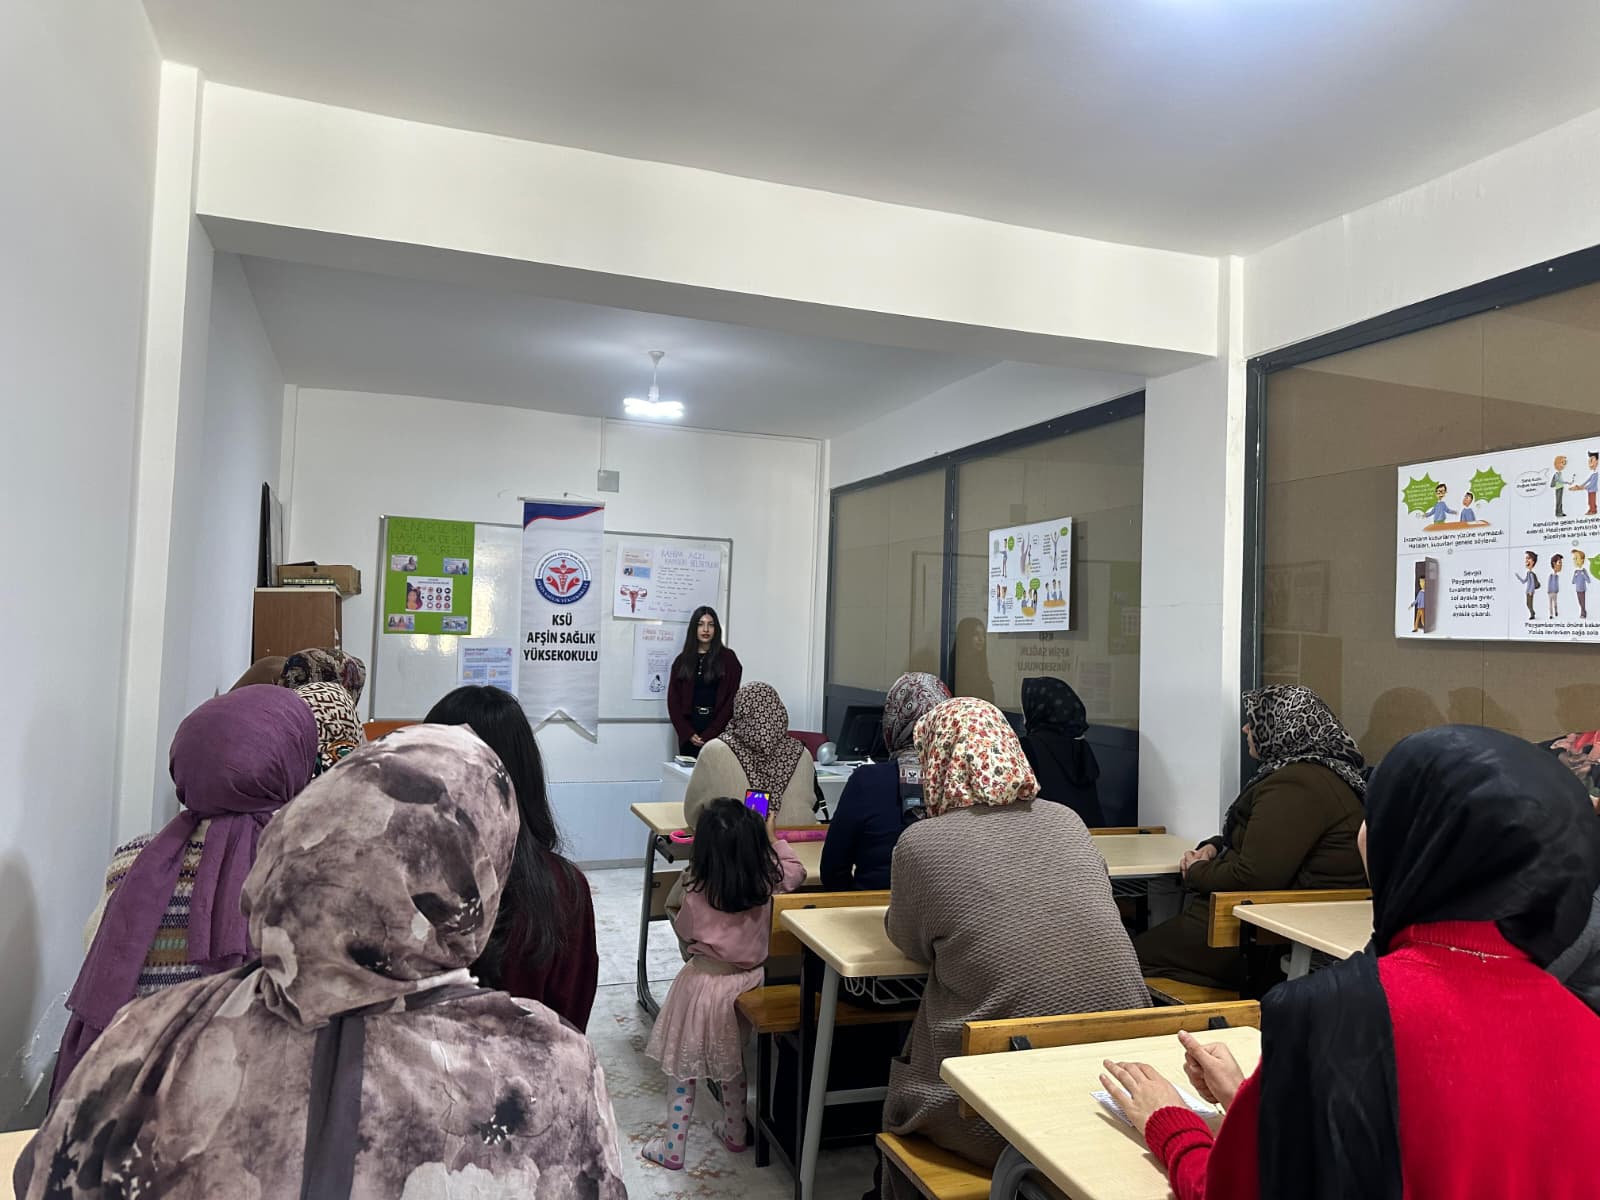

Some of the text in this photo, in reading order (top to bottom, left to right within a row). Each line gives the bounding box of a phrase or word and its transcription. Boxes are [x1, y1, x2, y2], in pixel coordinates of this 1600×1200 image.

[552, 612, 573, 626] KSÜ
[527, 629, 596, 646] AFŞİN SAĞLIK
[523, 647, 598, 662] YÜKSEKOKULU
